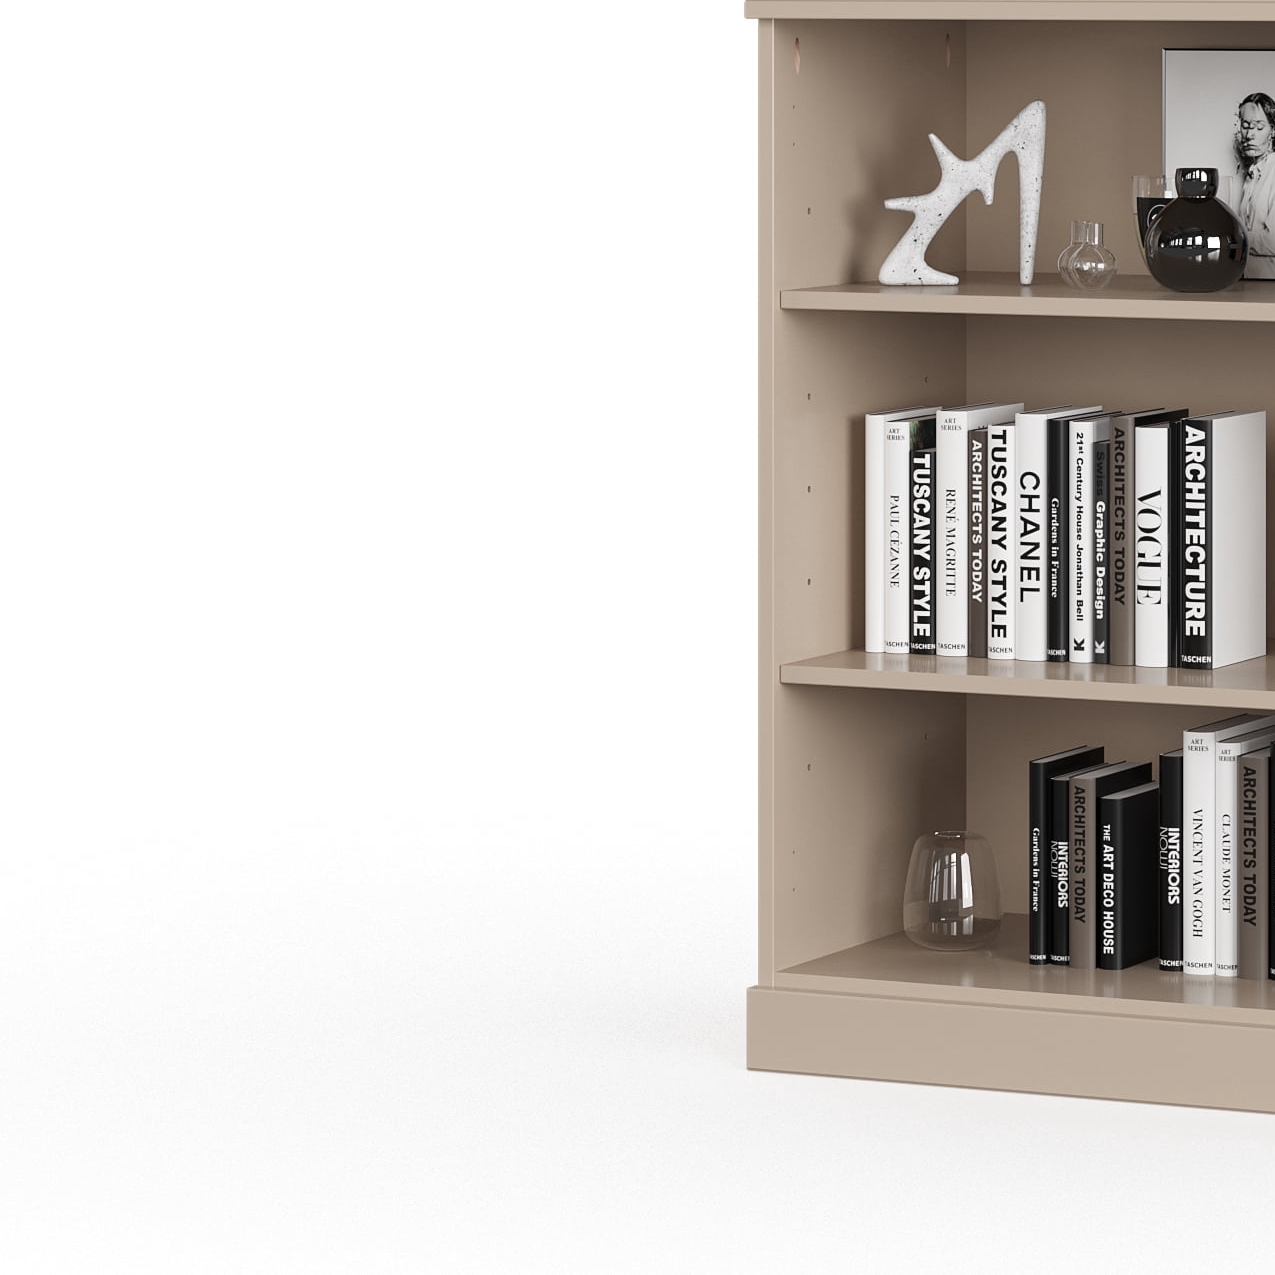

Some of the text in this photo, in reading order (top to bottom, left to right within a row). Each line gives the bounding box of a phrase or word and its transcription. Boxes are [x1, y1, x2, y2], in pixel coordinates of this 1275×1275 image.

[889, 494, 900, 527] PAUL
[912, 453, 931, 637] TUSCANY STYLE
[945, 527, 957, 597] MAGRITTE
[971, 439, 983, 603] ARCHITECTS TODAY
[990, 429, 1008, 639] TUSCANY STYLE
[1019, 471, 1041, 603] CHANEL
[1074, 432, 1084, 622] 21st Century House Jonathan Bell
[1094, 500, 1106, 620] Graphic Design
[1114, 426, 1126, 606] ARCHITECTS TODAY
[1136, 487, 1163, 605] VOGUE
[1184, 424, 1206, 637] ARCHITECTURE
[938, 642, 966, 651] TASCHEN
[1181, 654, 1212, 664] TASCHEN
[1057, 841, 1069, 908] INTERIORS
[1102, 823, 1115, 955] THE ART DECO HOUSE
[1167, 827, 1181, 905] INTERIORS
[1192, 808, 1203, 938] VINCENT VAN GOGH
[1222, 813, 1231, 914] CLAUDE MONET
[1242, 765, 1257, 927] ARCHITECTS TODAY
[1184, 961, 1213, 969] TASCHEN
